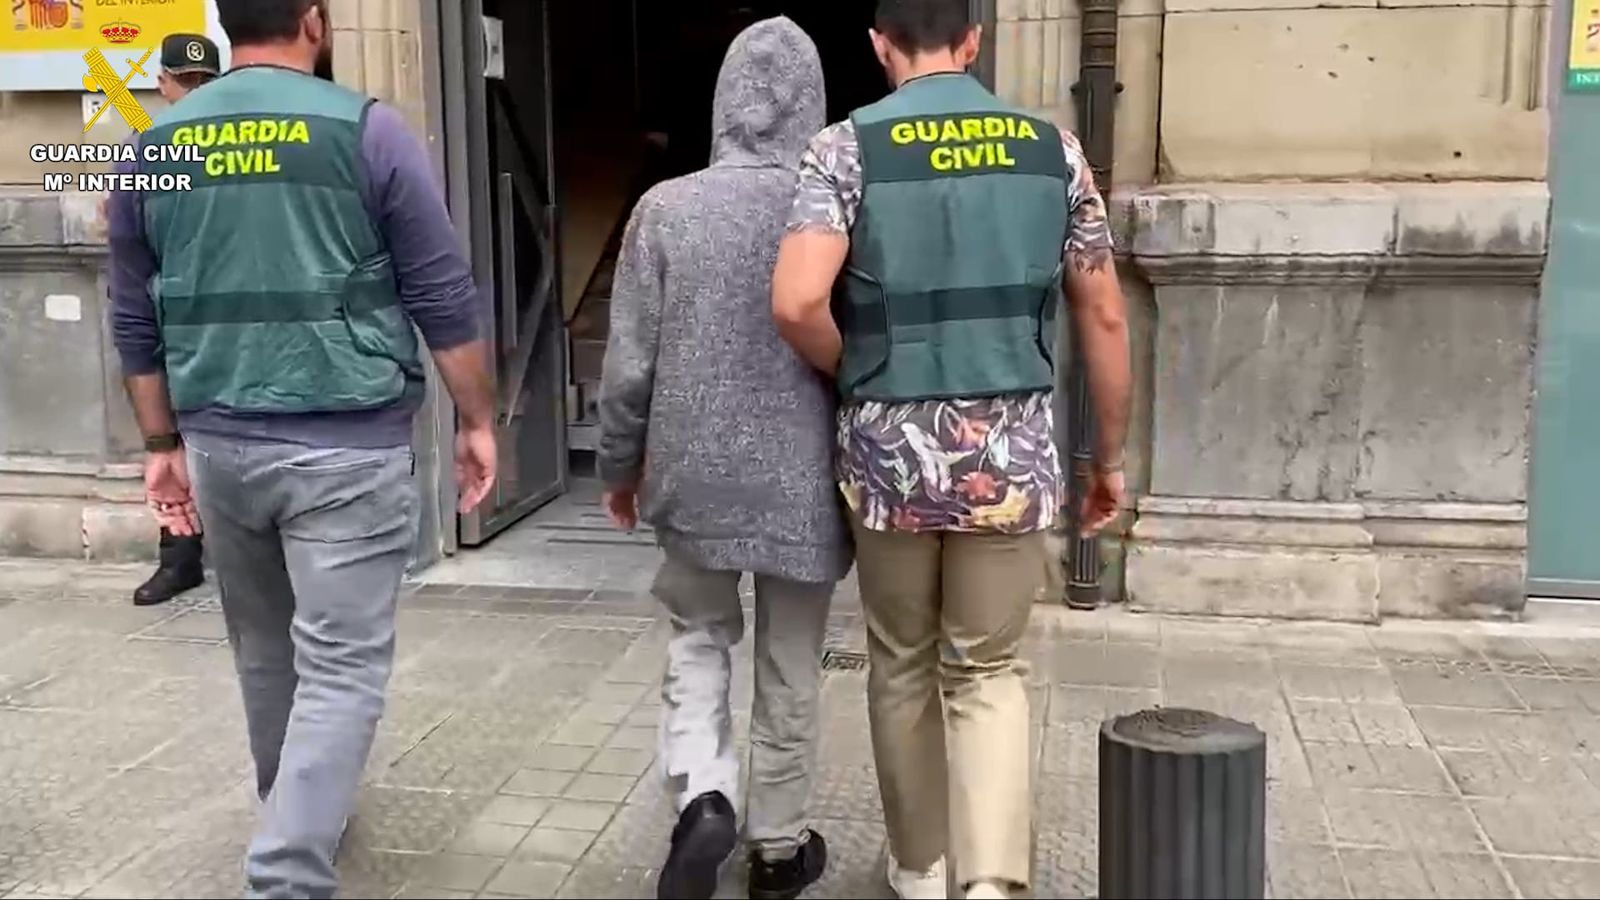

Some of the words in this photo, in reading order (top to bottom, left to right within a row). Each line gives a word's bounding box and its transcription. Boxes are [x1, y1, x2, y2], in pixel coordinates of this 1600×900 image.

[172, 119, 309, 147] GUARDIA
[891, 117, 1039, 145] GUARDIA
[205, 149, 280, 176] CIVIL
[930, 143, 1015, 171] CIVIL
